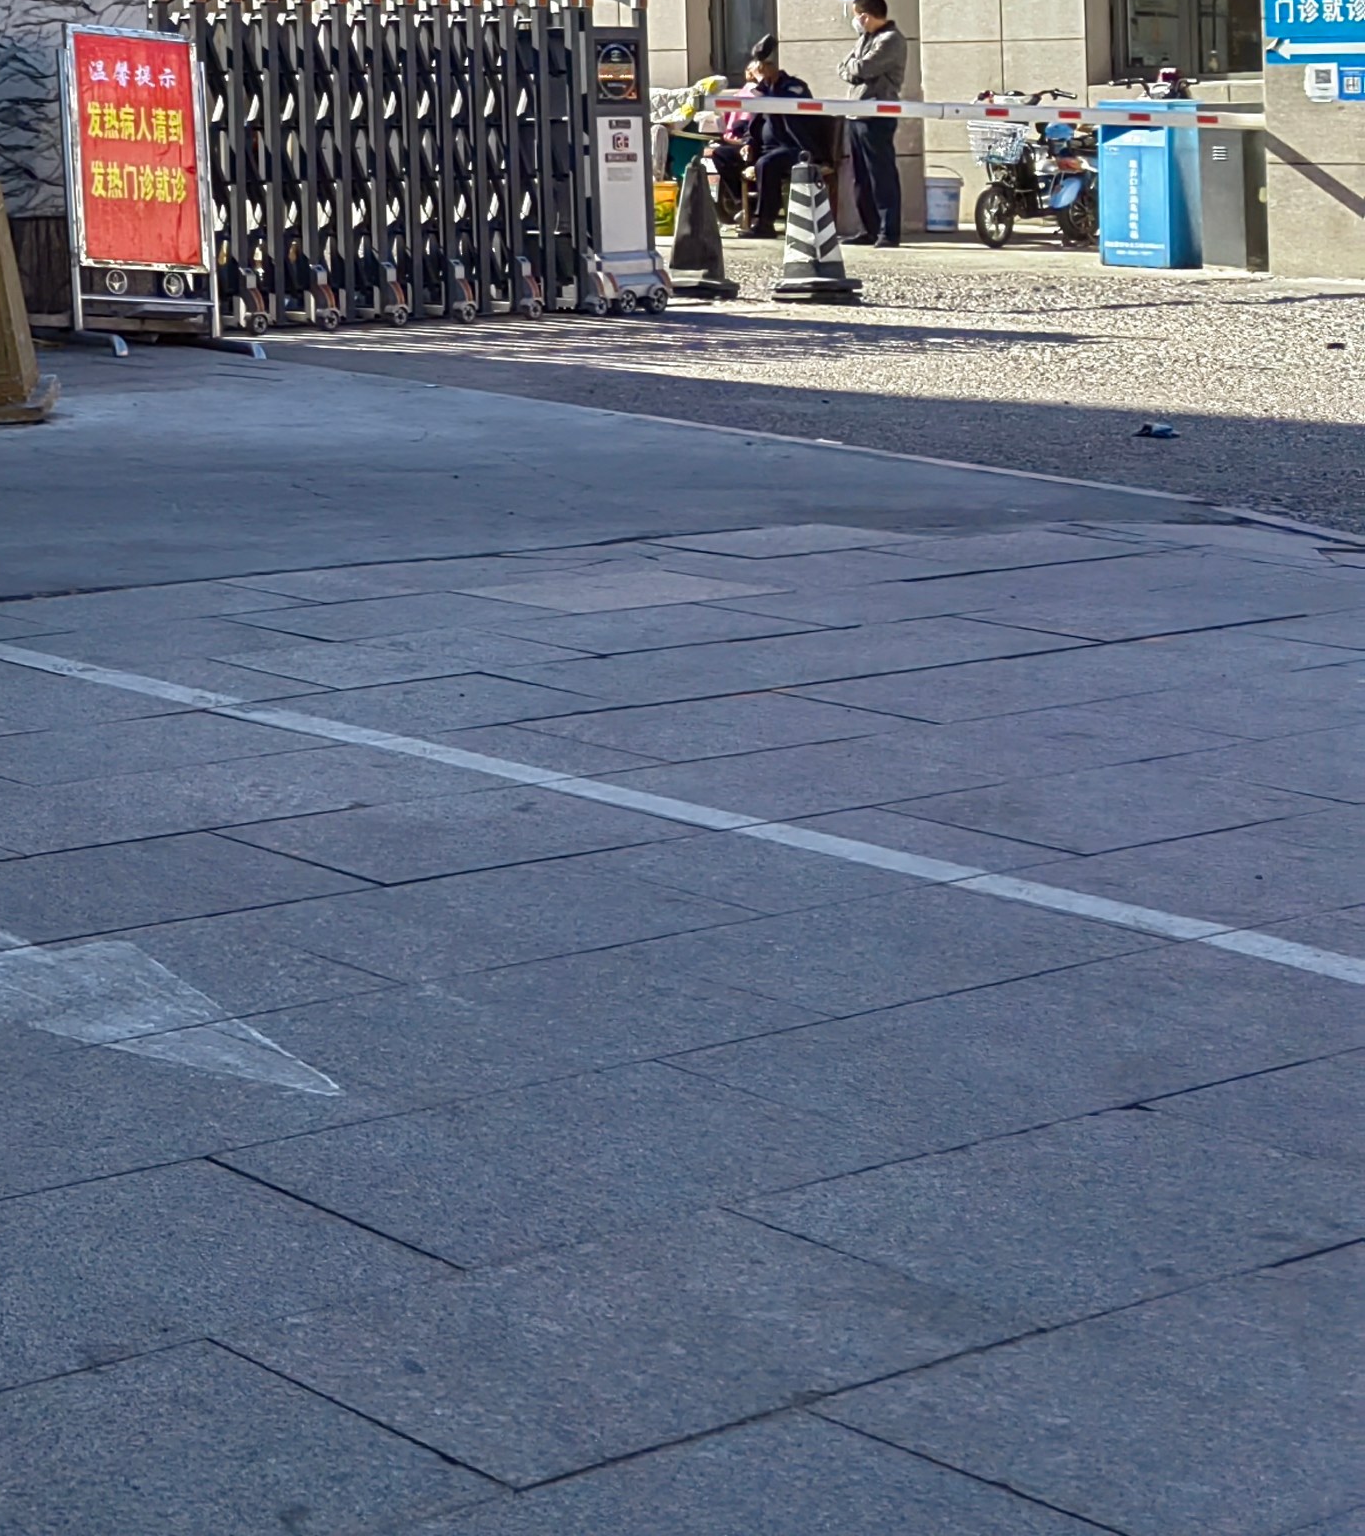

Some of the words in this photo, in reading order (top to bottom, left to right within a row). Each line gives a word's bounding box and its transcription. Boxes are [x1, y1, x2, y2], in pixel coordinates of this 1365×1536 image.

[88, 59, 177, 89] 温馨提示
[87, 101, 184, 145] 发热病人请到
[90, 160, 187, 204] 发热门诊就诊
